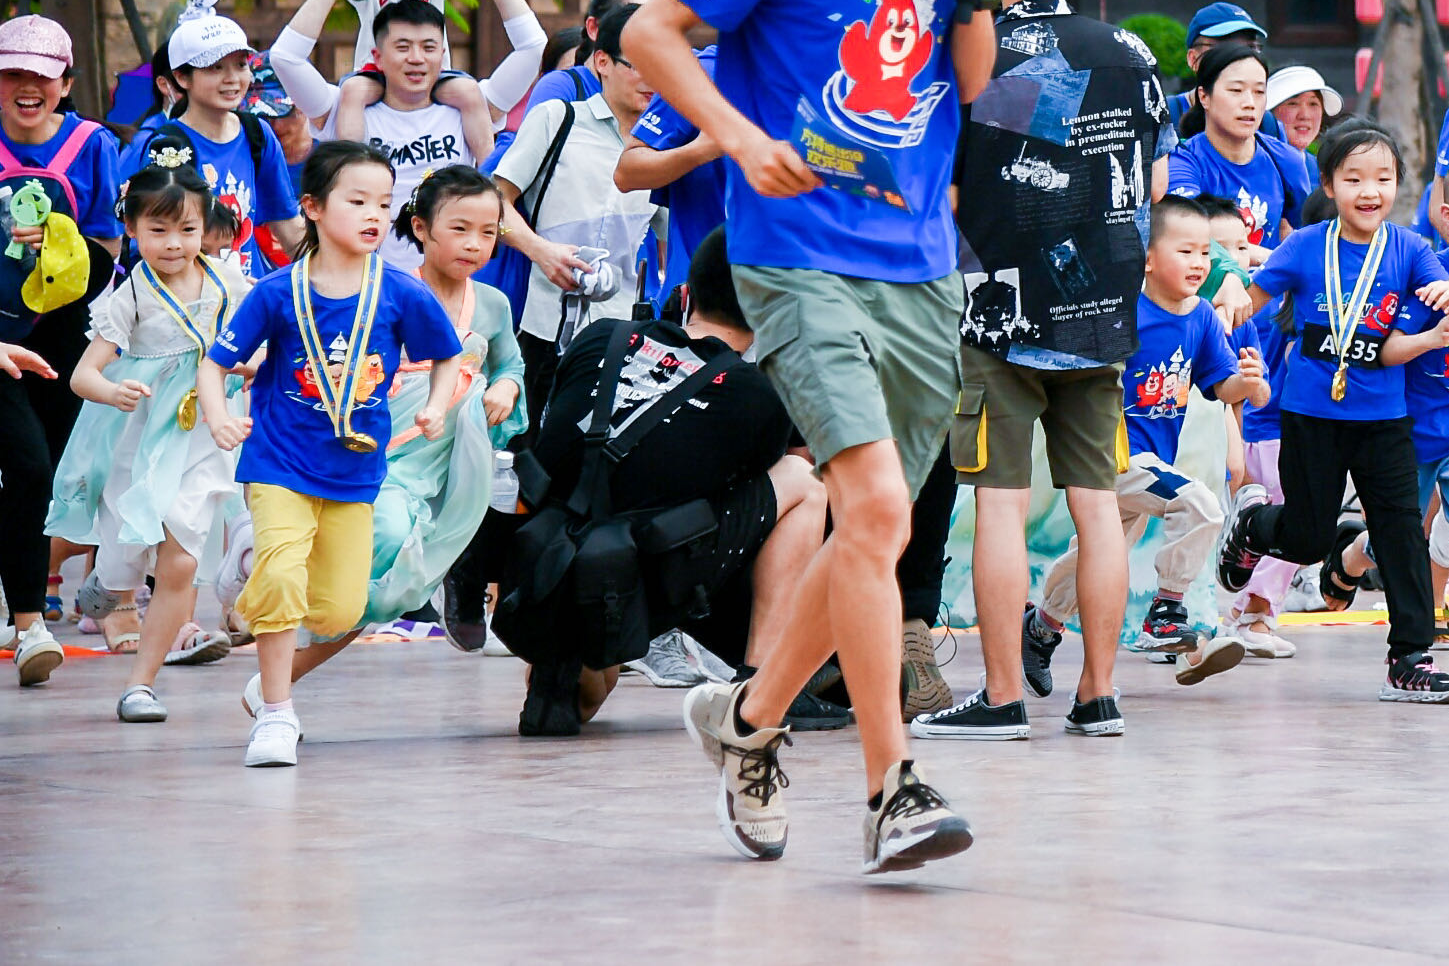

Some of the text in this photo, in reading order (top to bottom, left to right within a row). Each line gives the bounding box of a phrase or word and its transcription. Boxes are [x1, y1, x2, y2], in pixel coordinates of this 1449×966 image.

[1061, 107, 1133, 126] Lennon stalked
[1070, 119, 1128, 137] by ex-rocker
[1064, 129, 1136, 148] in premeditated
[1081, 142, 1125, 156] execution
[1049, 296, 1123, 314] Officials study alleged
[1318, 334, 1379, 362] A35
